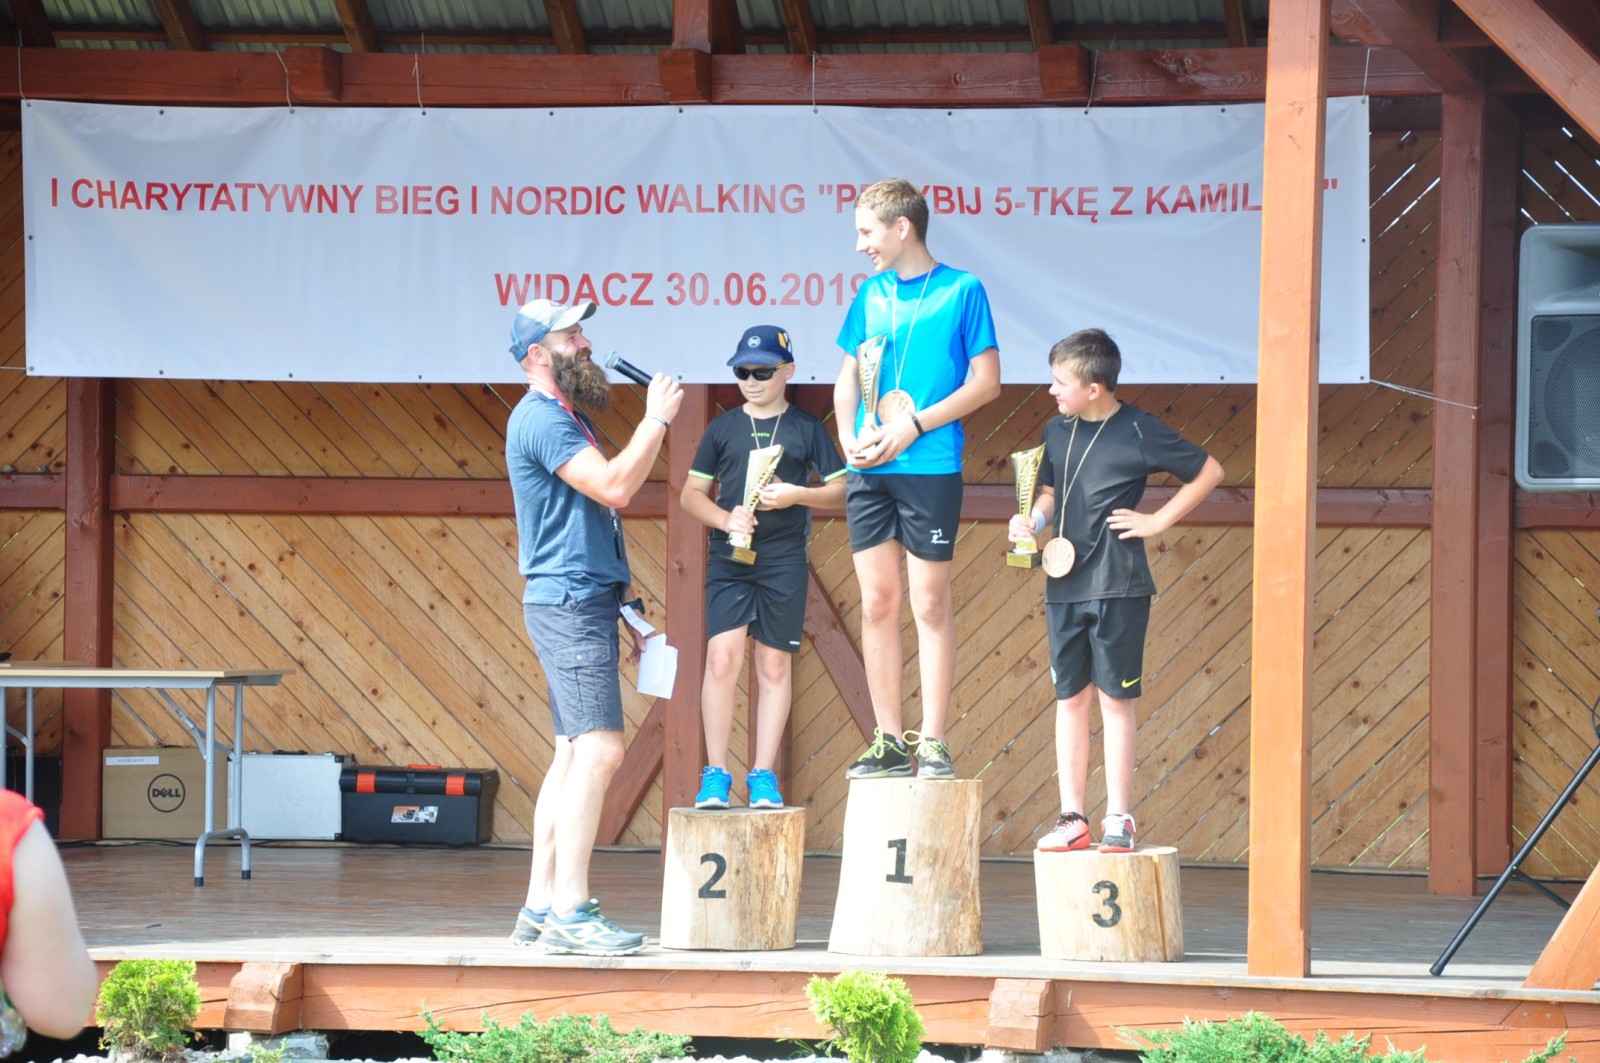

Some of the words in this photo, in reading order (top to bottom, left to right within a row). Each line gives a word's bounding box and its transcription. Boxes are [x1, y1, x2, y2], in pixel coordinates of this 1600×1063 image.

[51, 177, 59, 208] I
[71, 178, 364, 214] CHARYTATYWNY
[376, 185, 461, 216] BIEG
[471, 185, 479, 215] I
[490, 185, 626, 216] NORDIC
[636, 184, 806, 215] WALKING
[818, 183, 983, 216] "PBIJ
[995, 187, 1103, 224] 5-TKĘ
[1110, 186, 1134, 216] Z
[495, 273, 655, 307] WIDACZ
[151, 787, 182, 799] DELL
[697, 853, 727, 899] 2
[885, 838, 914, 884] 1
[1091, 880, 1123, 928] 3
